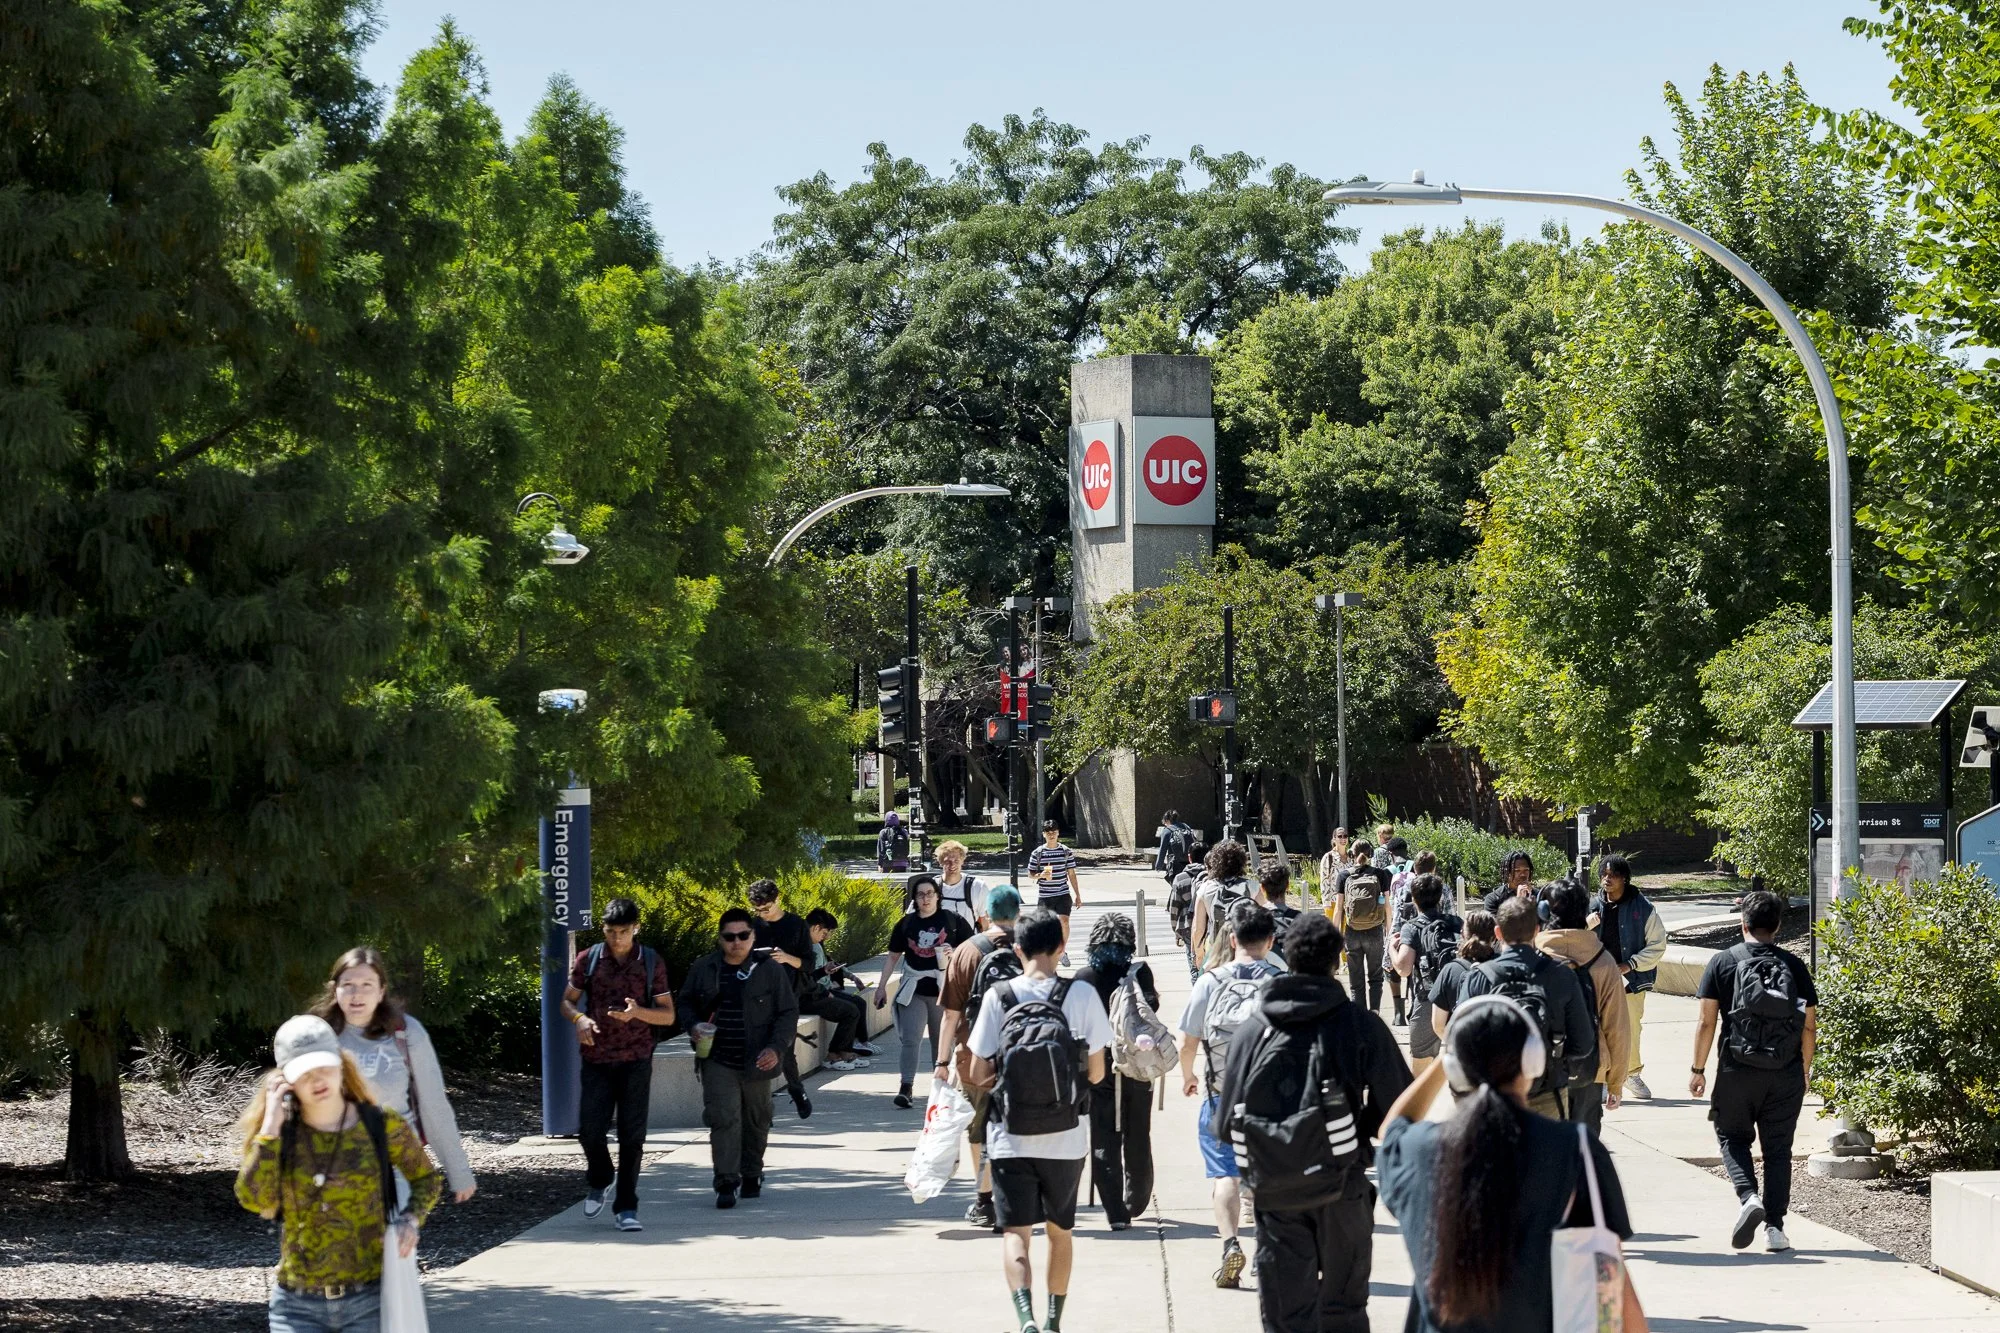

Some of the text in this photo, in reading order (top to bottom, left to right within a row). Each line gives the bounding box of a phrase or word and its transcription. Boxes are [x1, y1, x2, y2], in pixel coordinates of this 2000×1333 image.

[1084, 463, 1109, 489] UIC
[1149, 459, 1202, 484] UIC
[1858, 818, 1901, 826] arrison St
[551, 810, 573, 926] Emergency
